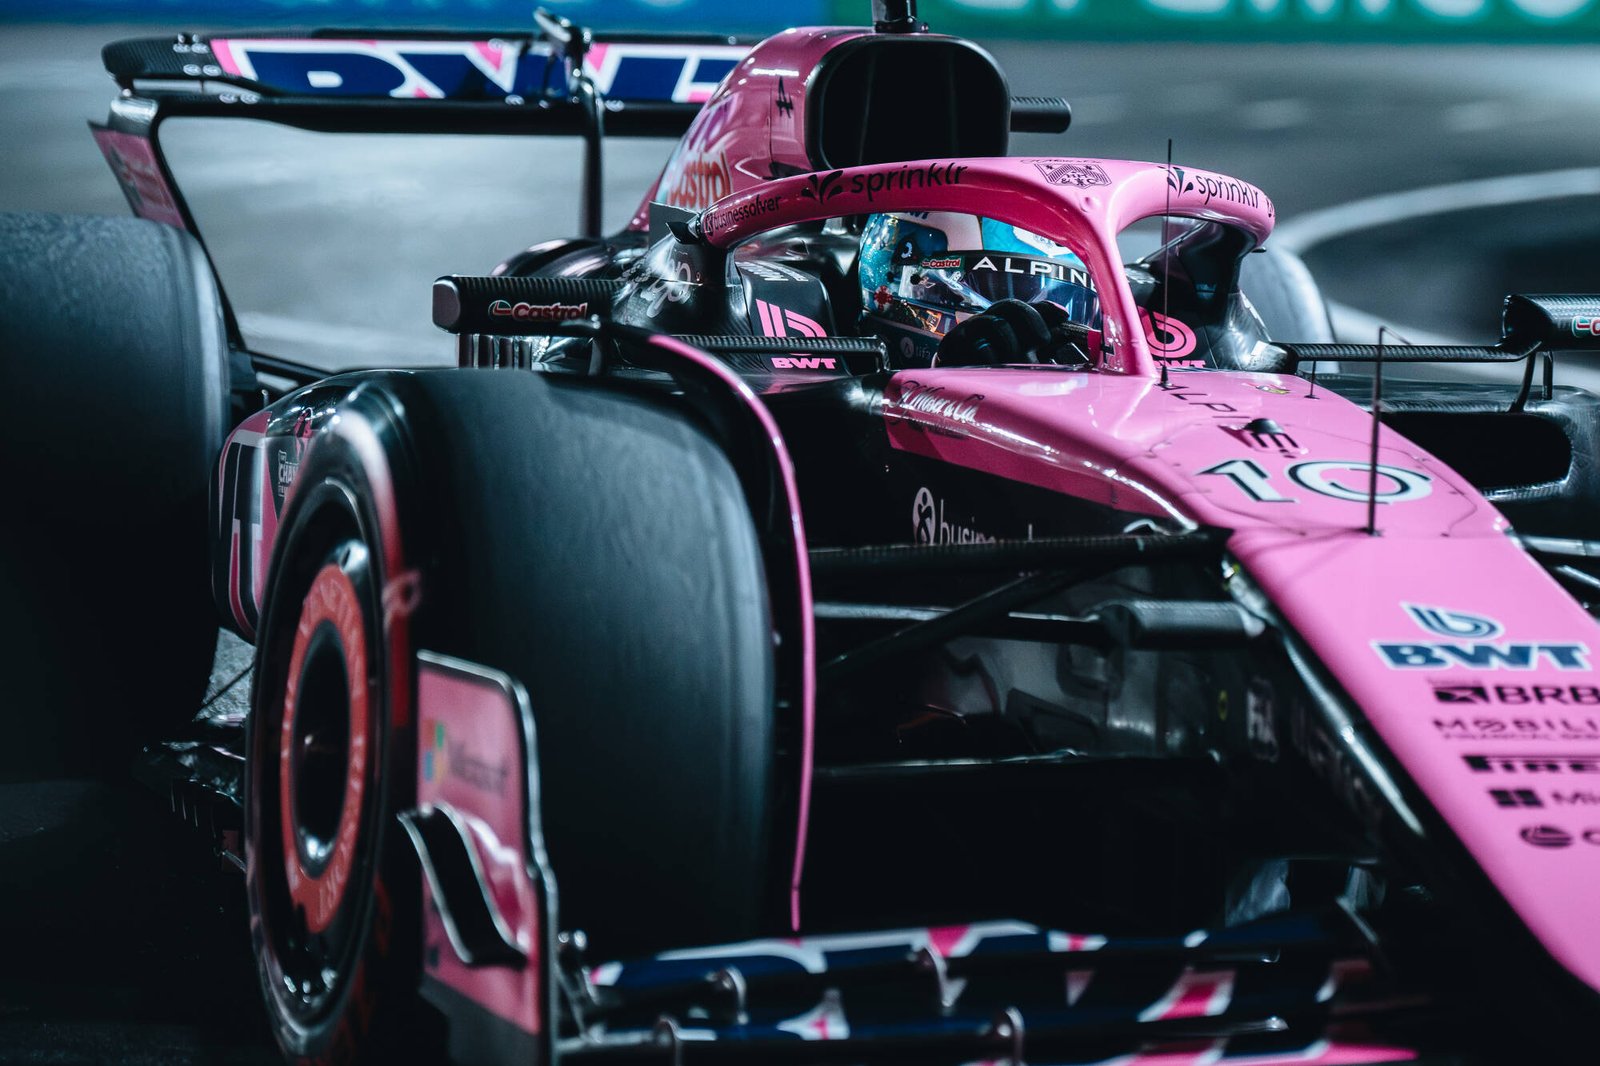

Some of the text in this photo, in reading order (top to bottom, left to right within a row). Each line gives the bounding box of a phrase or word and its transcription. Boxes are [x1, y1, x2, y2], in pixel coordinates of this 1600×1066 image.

[851, 162, 968, 202] sprinklr
[1196, 175, 1259, 209] sprinklr
[930, 258, 961, 268] Castrol
[512, 302, 588, 320] Castrol
[771, 357, 836, 369] BWT
[1196, 459, 1433, 505] 10
[1371, 640, 1592, 670] BWT
[1432, 717, 1600, 735] MOBILI
[1460, 754, 1600, 773] PIRE
